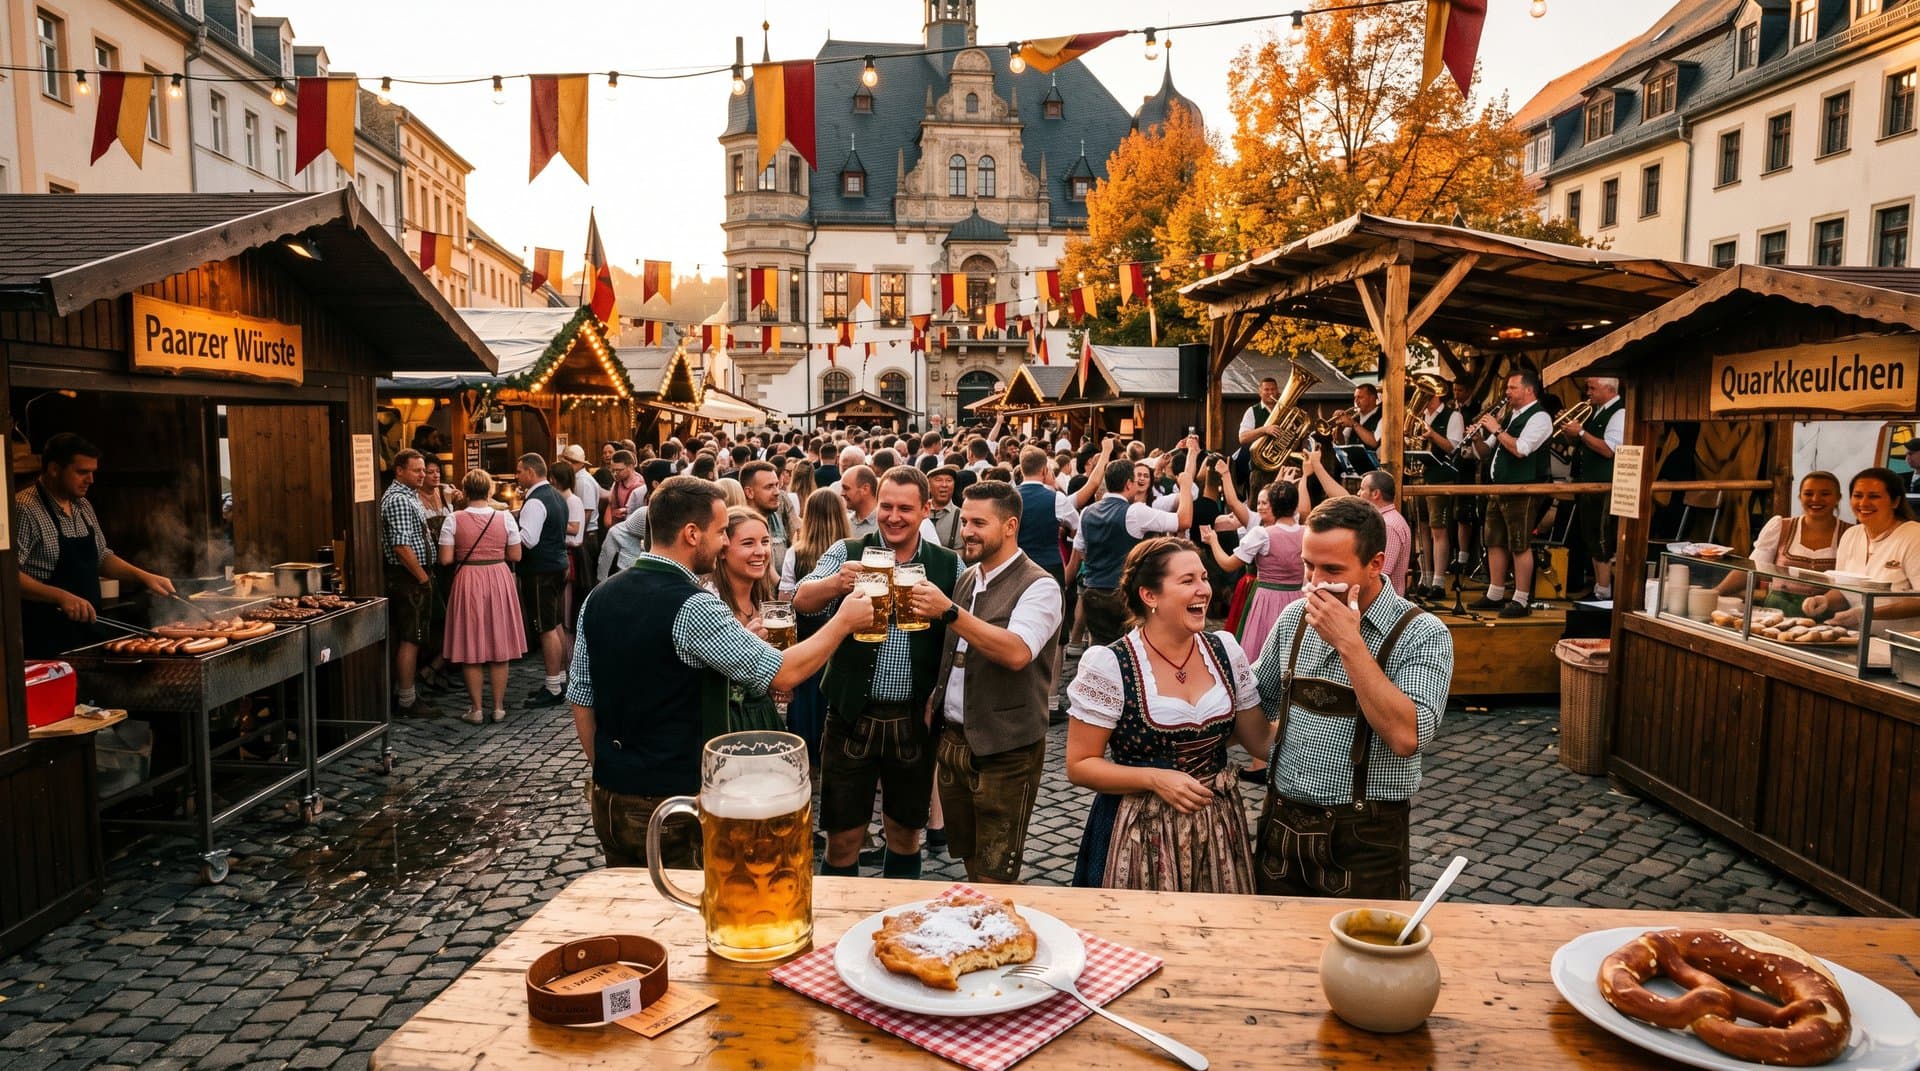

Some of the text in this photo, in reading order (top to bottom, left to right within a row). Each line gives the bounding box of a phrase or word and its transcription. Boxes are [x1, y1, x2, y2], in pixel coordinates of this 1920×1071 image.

[146, 314, 295, 366] Paarzer Würste
[1721, 353, 1904, 402] Quarkkeulchen
